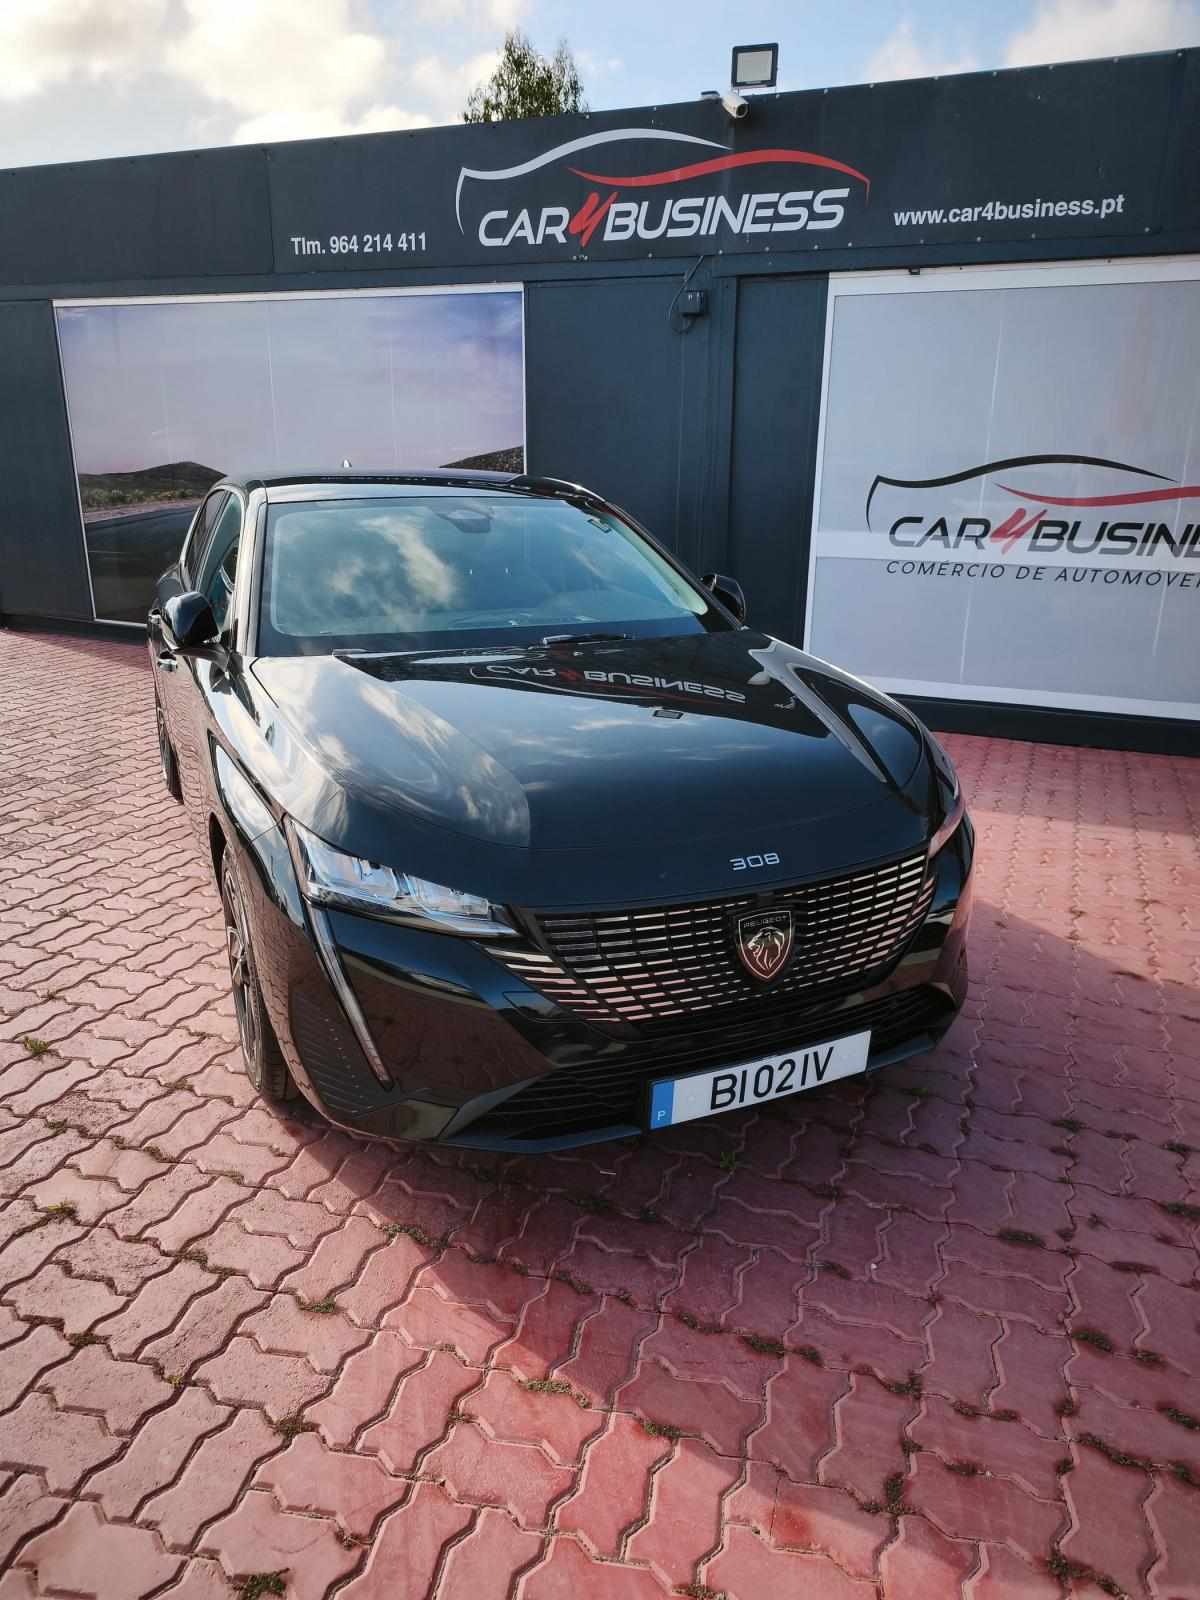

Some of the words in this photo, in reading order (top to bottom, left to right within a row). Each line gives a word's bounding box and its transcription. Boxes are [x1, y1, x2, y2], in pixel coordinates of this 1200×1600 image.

[893, 194, 1125, 227] www.car4business.pt
[290, 237, 326, 255] Tlm.
[329, 235, 359, 254] 964
[363, 233, 393, 253] 214
[397, 232, 426, 251] 411
[886, 560, 1005, 579] COMÉRCIO
[1015, 566, 1046, 581] DE
[729, 852, 780, 871] 308
[657, 1110, 667, 1121] P
